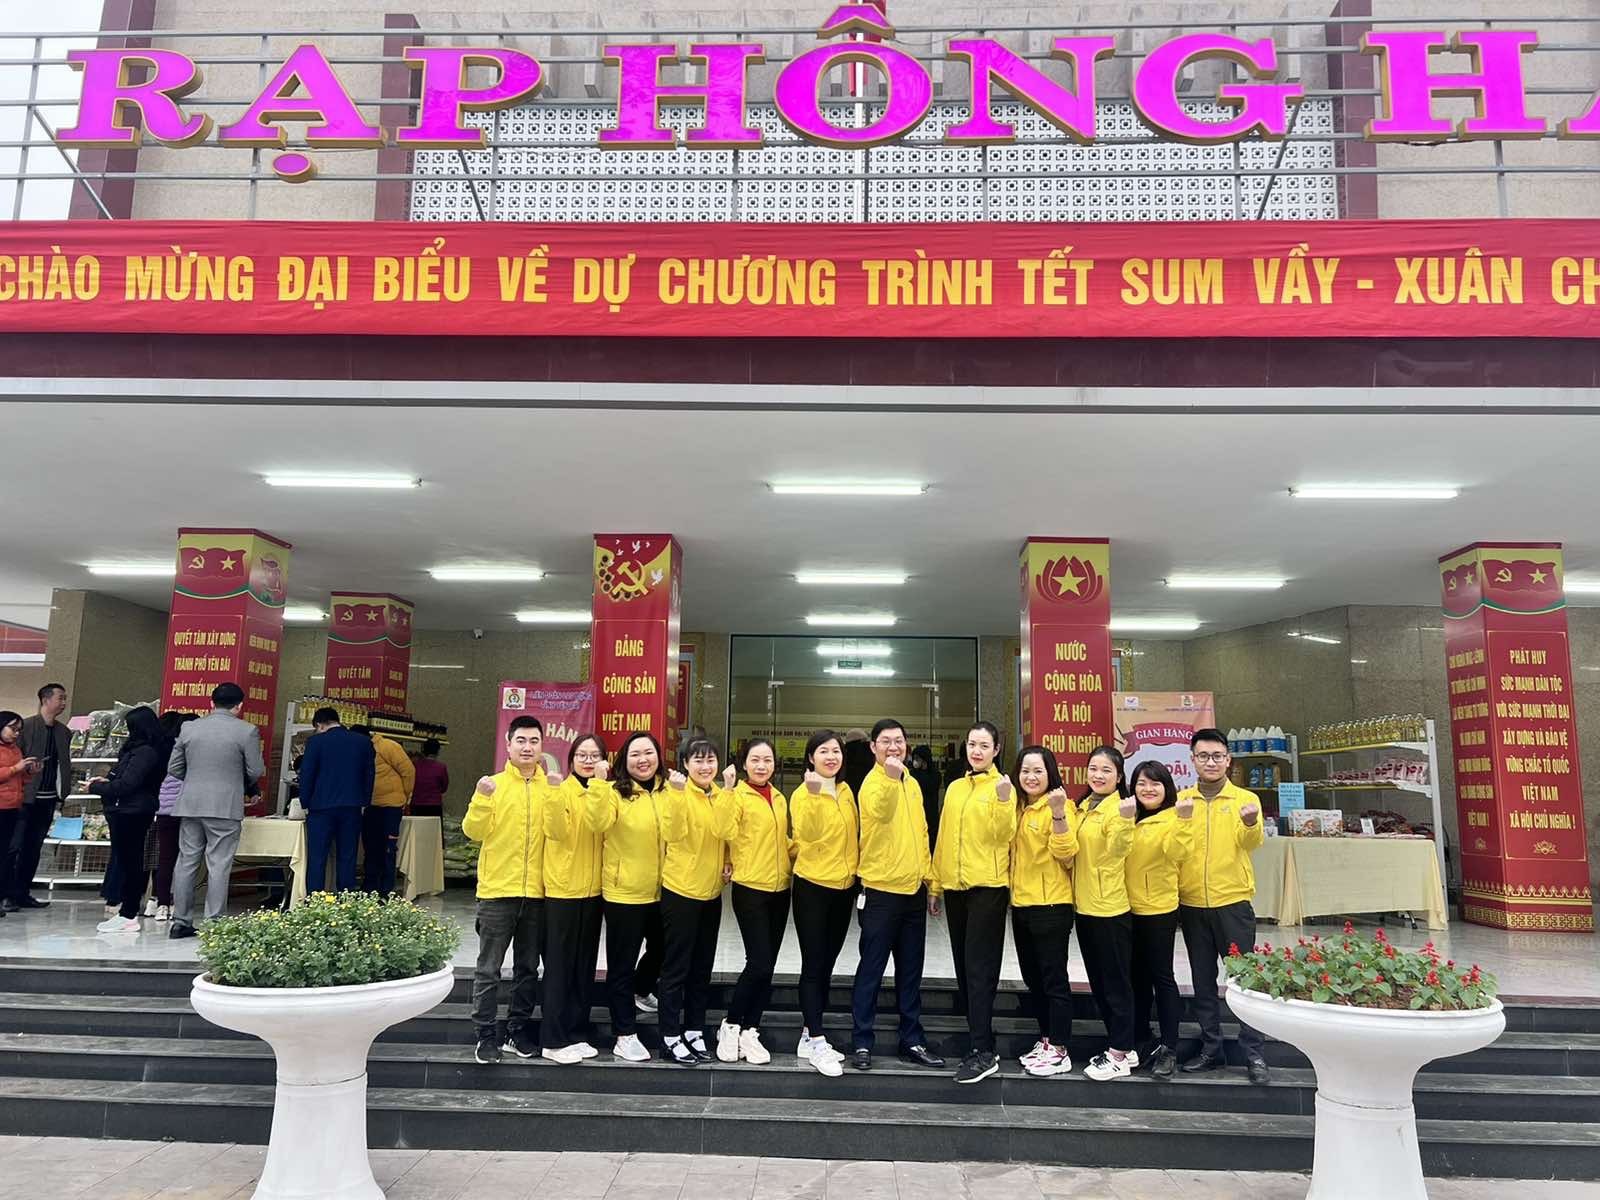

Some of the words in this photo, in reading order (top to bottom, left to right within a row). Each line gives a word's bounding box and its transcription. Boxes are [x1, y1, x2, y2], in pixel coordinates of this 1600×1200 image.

[55, 43, 546, 183] RẠP
[1359, 30, 1600, 143] H
[0, 245, 101, 301] CHÀO
[124, 245, 255, 302] MỪNG
[277, 256, 349, 310] ĐẠI
[373, 237, 471, 302] BIỂU
[497, 244, 549, 303] VỀ
[572, 253, 637, 313] DỰ
[658, 253, 837, 305] CHƯƠNG
[862, 249, 993, 305] TRÌNH
[1017, 246, 1095, 305] TẾT
[1120, 258, 1224, 305] SUM
[1252, 243, 1340, 304] VẦY
[1394, 246, 1524, 304] XUÂN
[615, 634, 644, 656] ĐẢNG
[1055, 639, 1087, 661] NƯỚC
[1509, 648, 1529, 664] PHÁT
[1531, 650, 1546, 665] HUY
[603, 672, 632, 698] CỘNG
[634, 670, 656, 694] SẢN
[1044, 669, 1076, 695] CỘNG
[1079, 669, 1103, 692] HÒA
[602, 710, 624, 735] VIỆT
[626, 713, 651, 731] NAM
[1053, 700, 1069, 722] XÃ
[1072, 700, 1092, 726] HỘI
[545, 722, 578, 744] HÀN
[1042, 729, 1065, 753] CHỦ
[1135, 728, 1160, 740] GIAN
[1073, 767, 1088, 785] NA
[1521, 782, 1539, 804] VIỆT
[1540, 785, 1559, 801] NAM
[1509, 810, 1520, 828] XÃ
